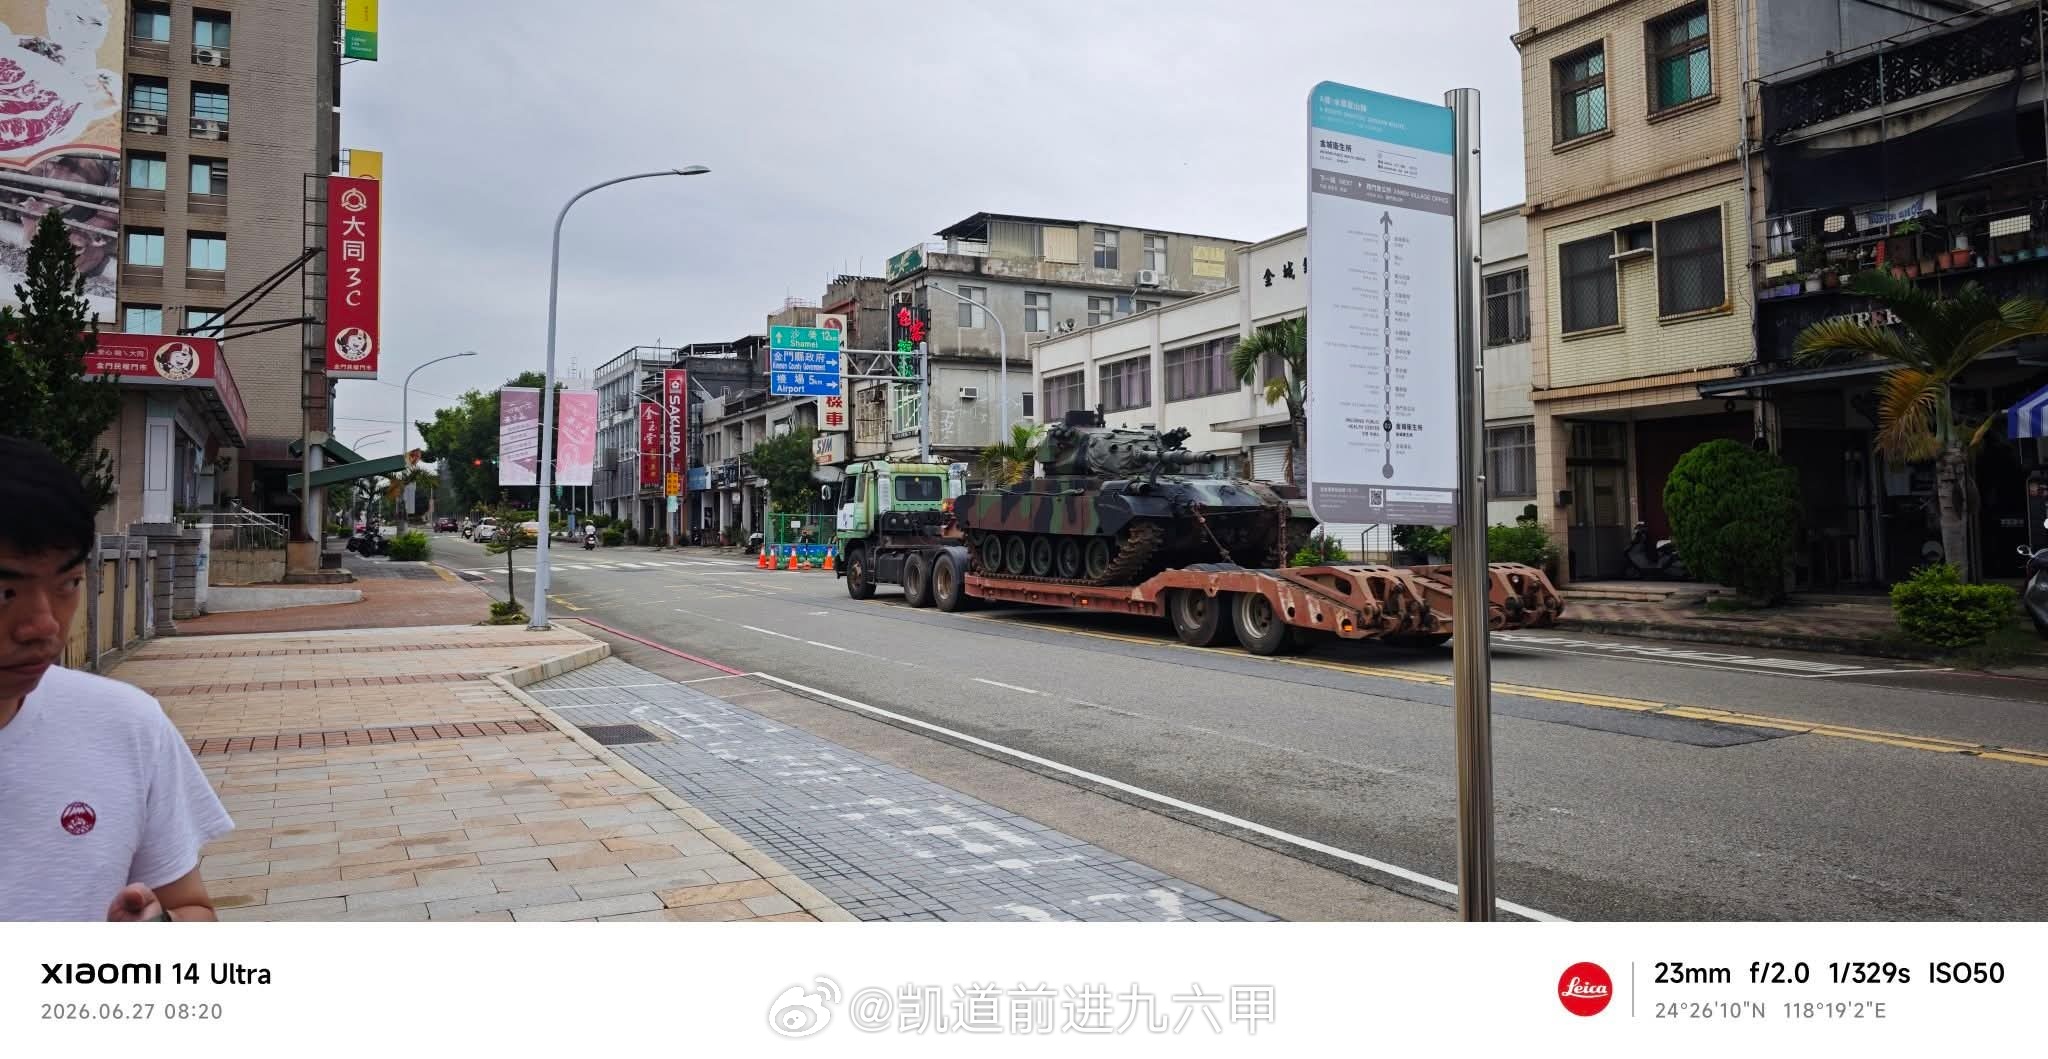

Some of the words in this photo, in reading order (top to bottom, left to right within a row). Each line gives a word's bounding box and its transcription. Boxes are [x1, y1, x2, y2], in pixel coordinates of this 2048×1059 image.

[1263, 257, 1308, 287] 金城
[773, 350, 825, 362] 金門縣政府
[776, 384, 805, 393] Airport
[669, 395, 681, 455] SAKURA
[817, 437, 833, 455] SYM
